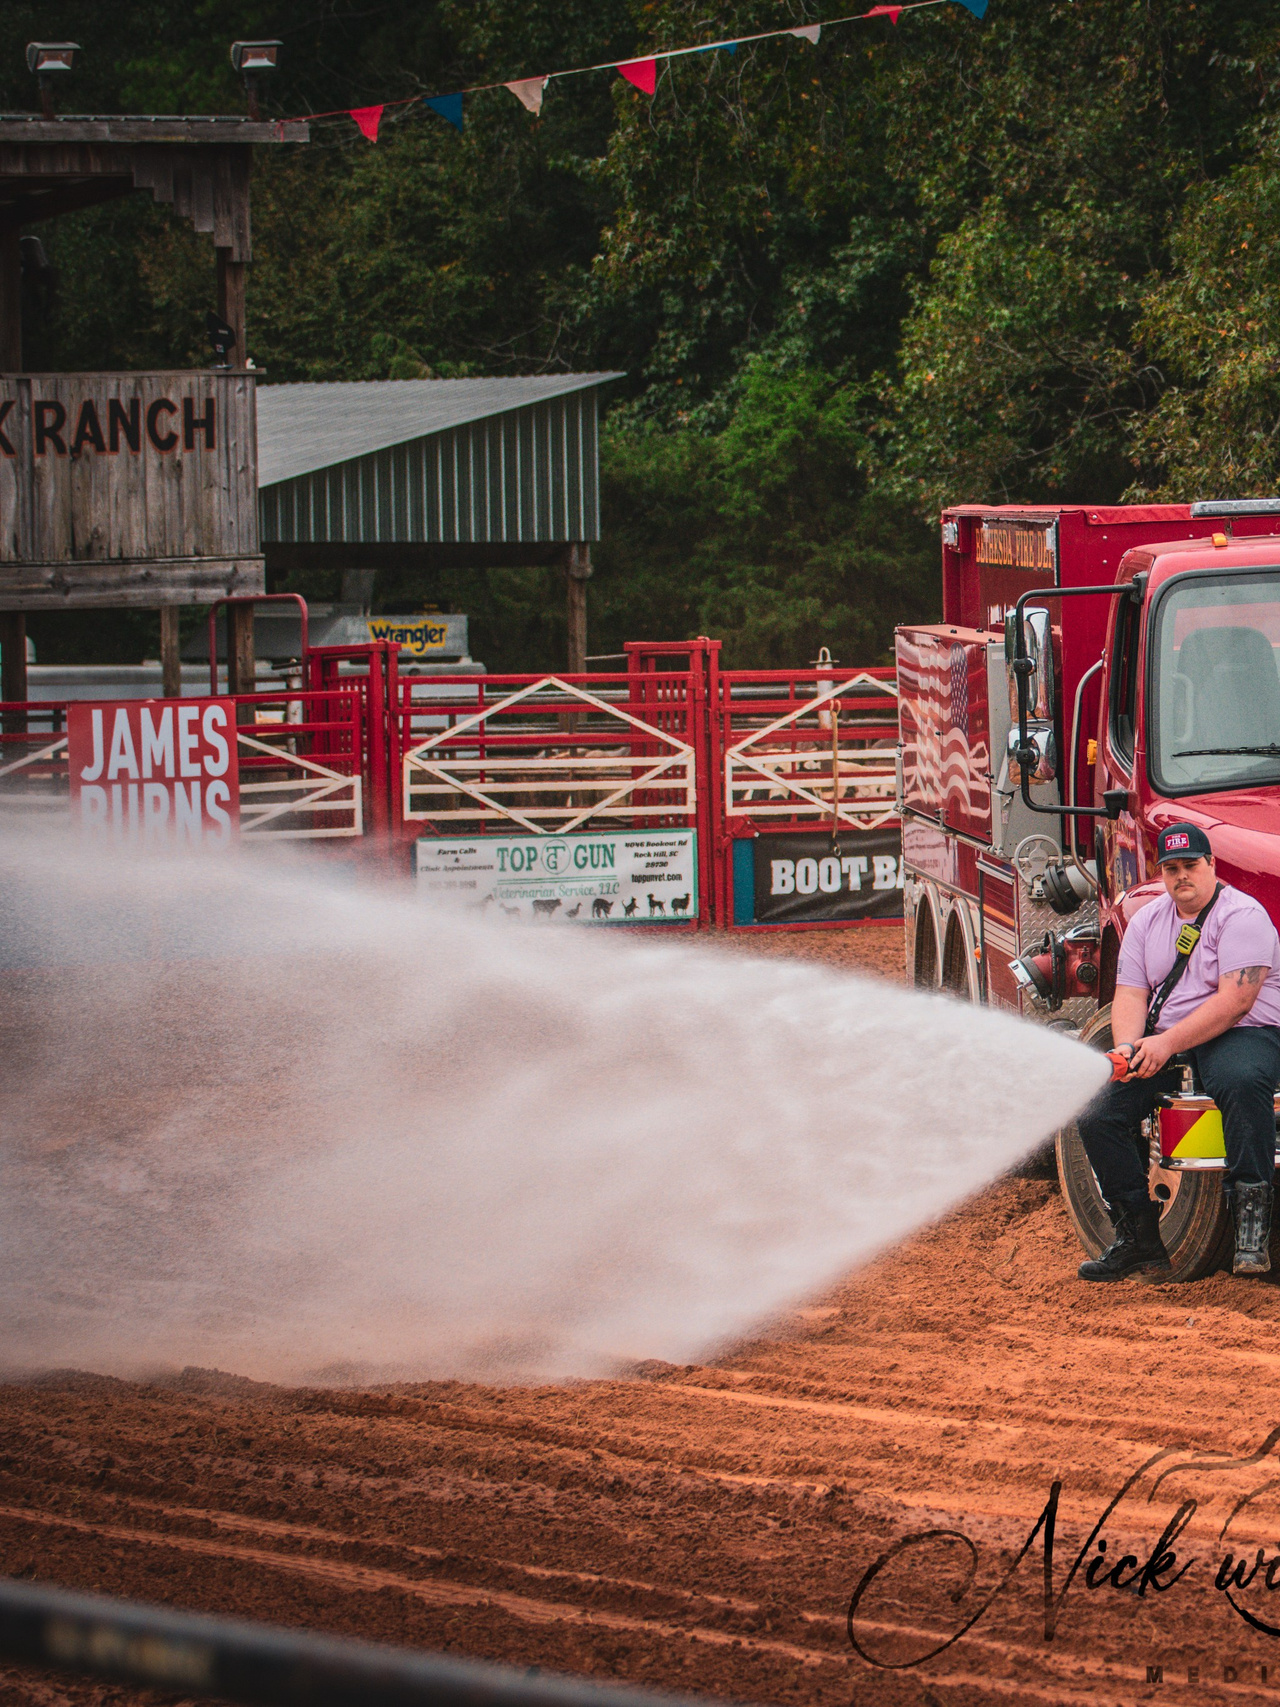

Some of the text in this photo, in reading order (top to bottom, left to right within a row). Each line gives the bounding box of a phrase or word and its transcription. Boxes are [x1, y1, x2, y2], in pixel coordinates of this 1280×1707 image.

[32, 397, 217, 458] RANCH
[975, 528, 1013, 566] BETHESDA
[1015, 530, 1034, 568] FIRE
[371, 624, 446, 652] Wrangler
[80, 705, 229, 781] JAMES
[80, 780, 232, 851] BURNS
[497, 846, 539, 872] TOP
[573, 843, 616, 869] GUN
[653, 850, 668, 858] Hill,
[1167, 837, 1187, 847] FIRE
[492, 882, 620, 899] Veterinarian Service, LLC
[770, 856, 868, 895] BOOT
